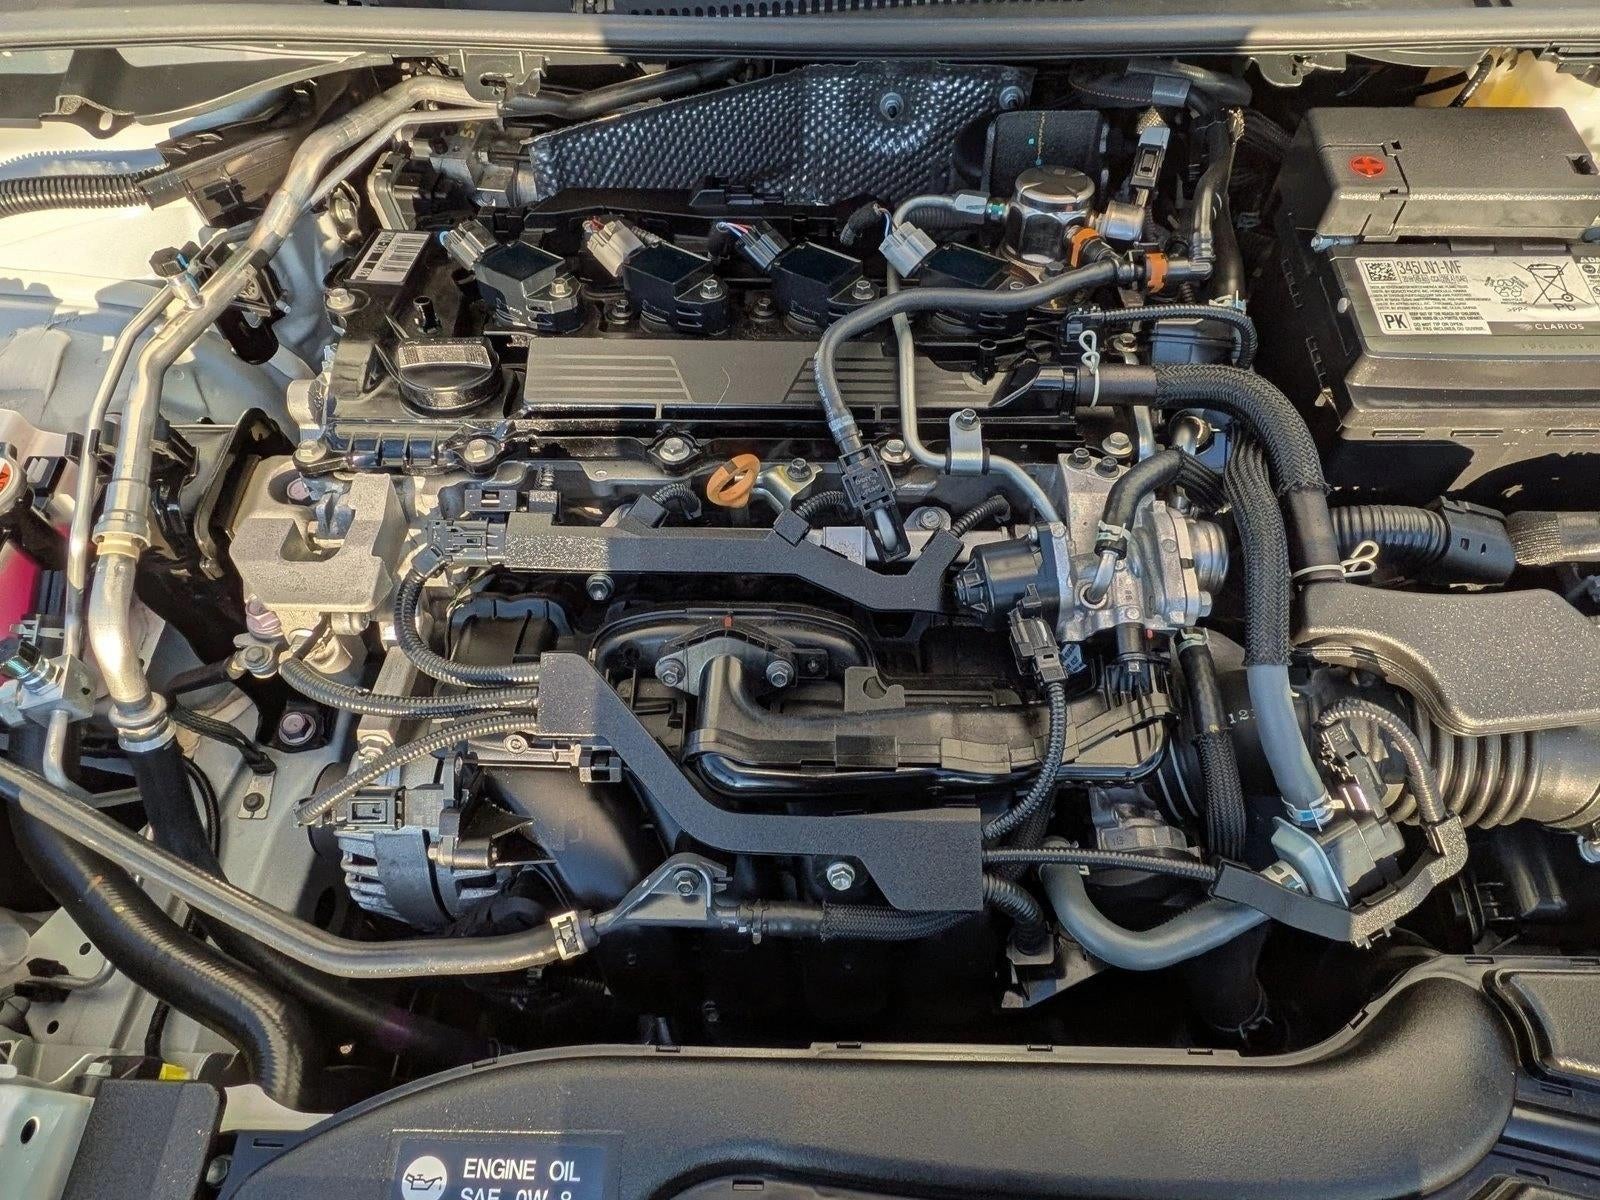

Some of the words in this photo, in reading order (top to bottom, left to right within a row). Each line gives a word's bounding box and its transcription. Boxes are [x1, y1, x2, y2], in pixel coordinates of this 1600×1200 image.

[1396, 260, 1462, 275] 345LN1-MF
[1553, 302, 1576, 311] Pb
[1384, 314, 1408, 329] PK
[463, 1158, 537, 1181] ENGINE
[549, 1160, 581, 1182] OIL
